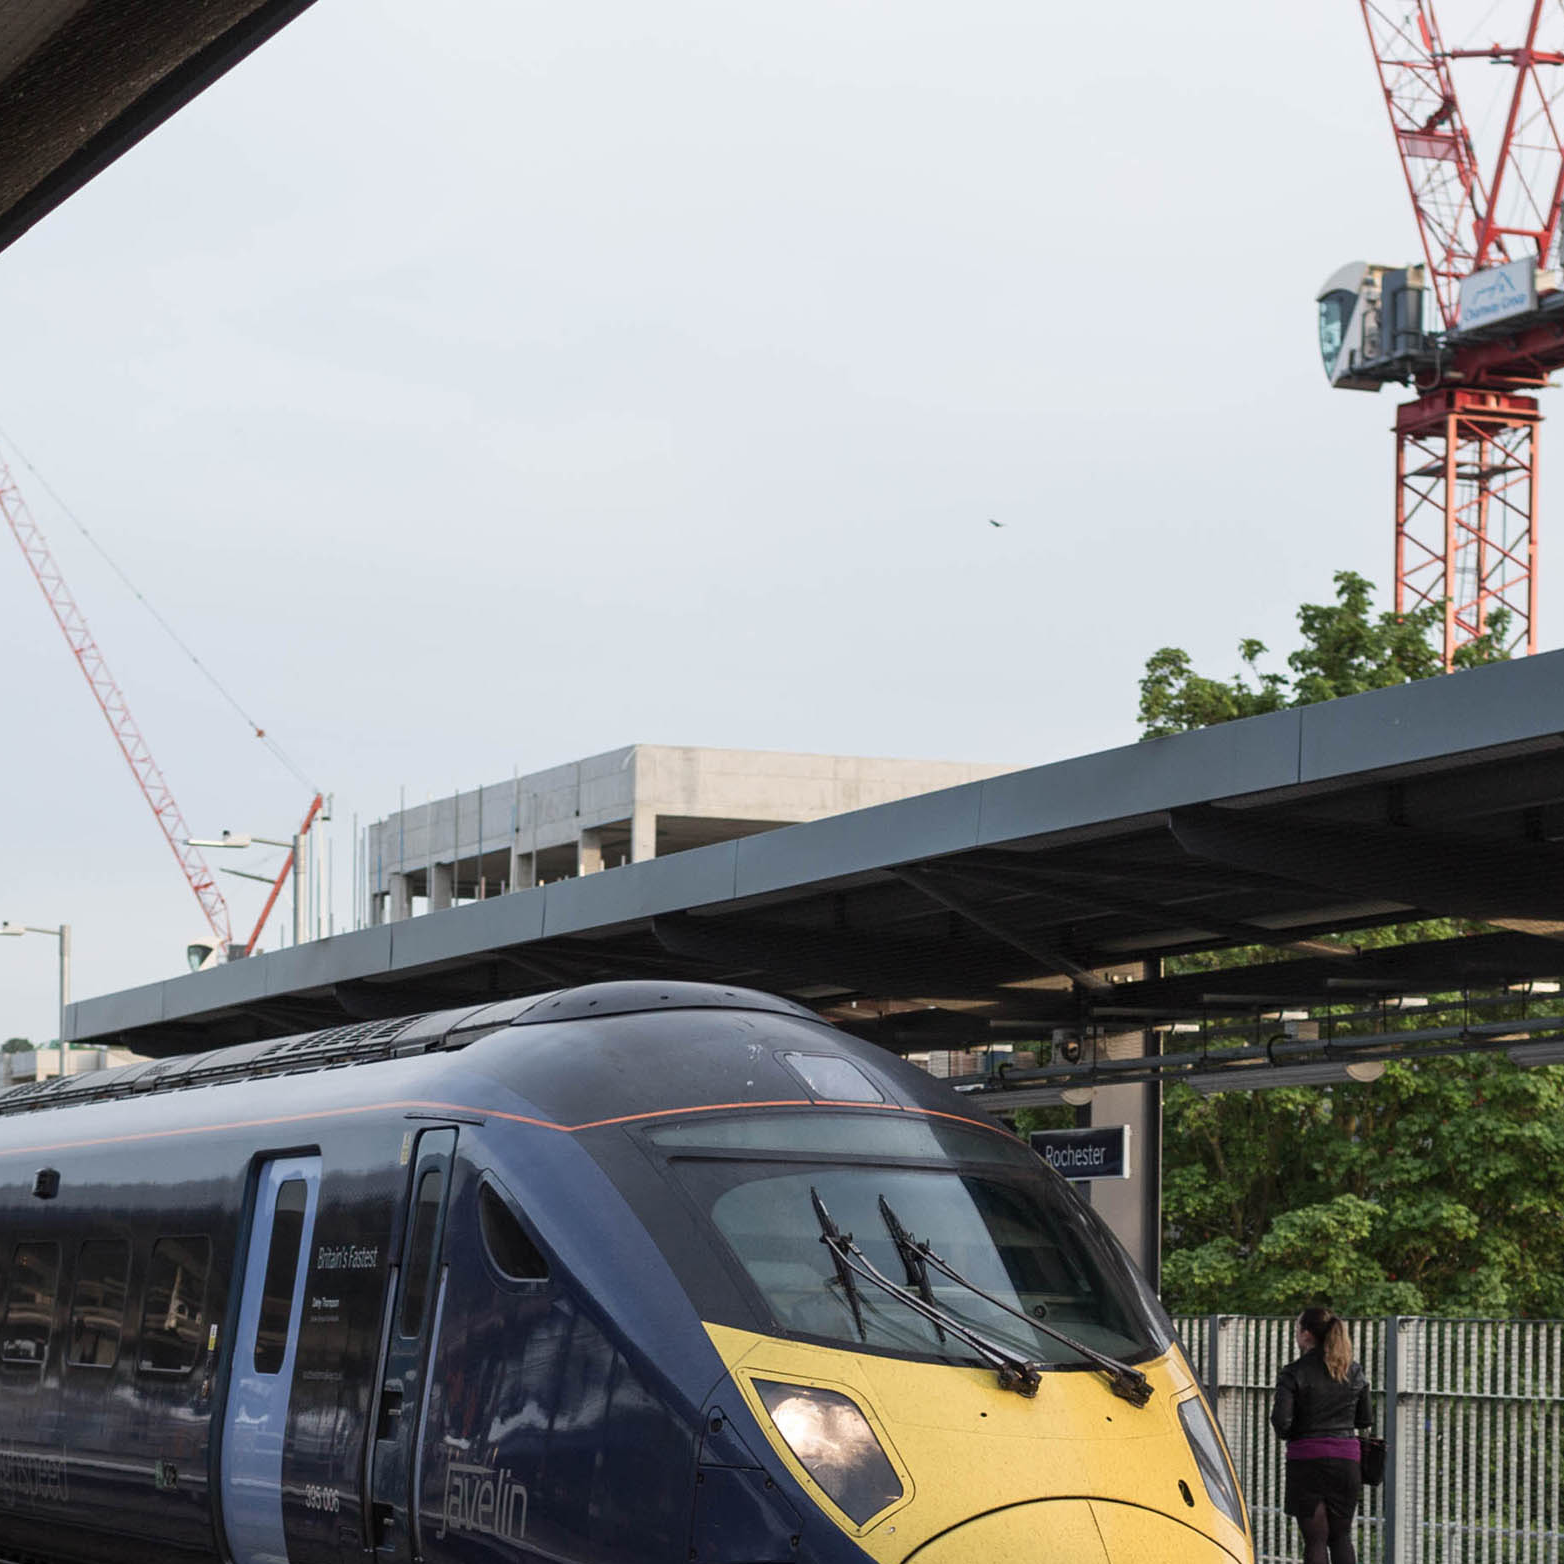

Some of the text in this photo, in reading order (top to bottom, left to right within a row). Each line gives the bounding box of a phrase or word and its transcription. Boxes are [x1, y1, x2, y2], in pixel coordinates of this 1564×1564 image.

[1045, 1144, 1106, 1167] Rochester
[317, 1245, 378, 1270] Britain's Fastest
[305, 1484, 340, 1512] 395 006
